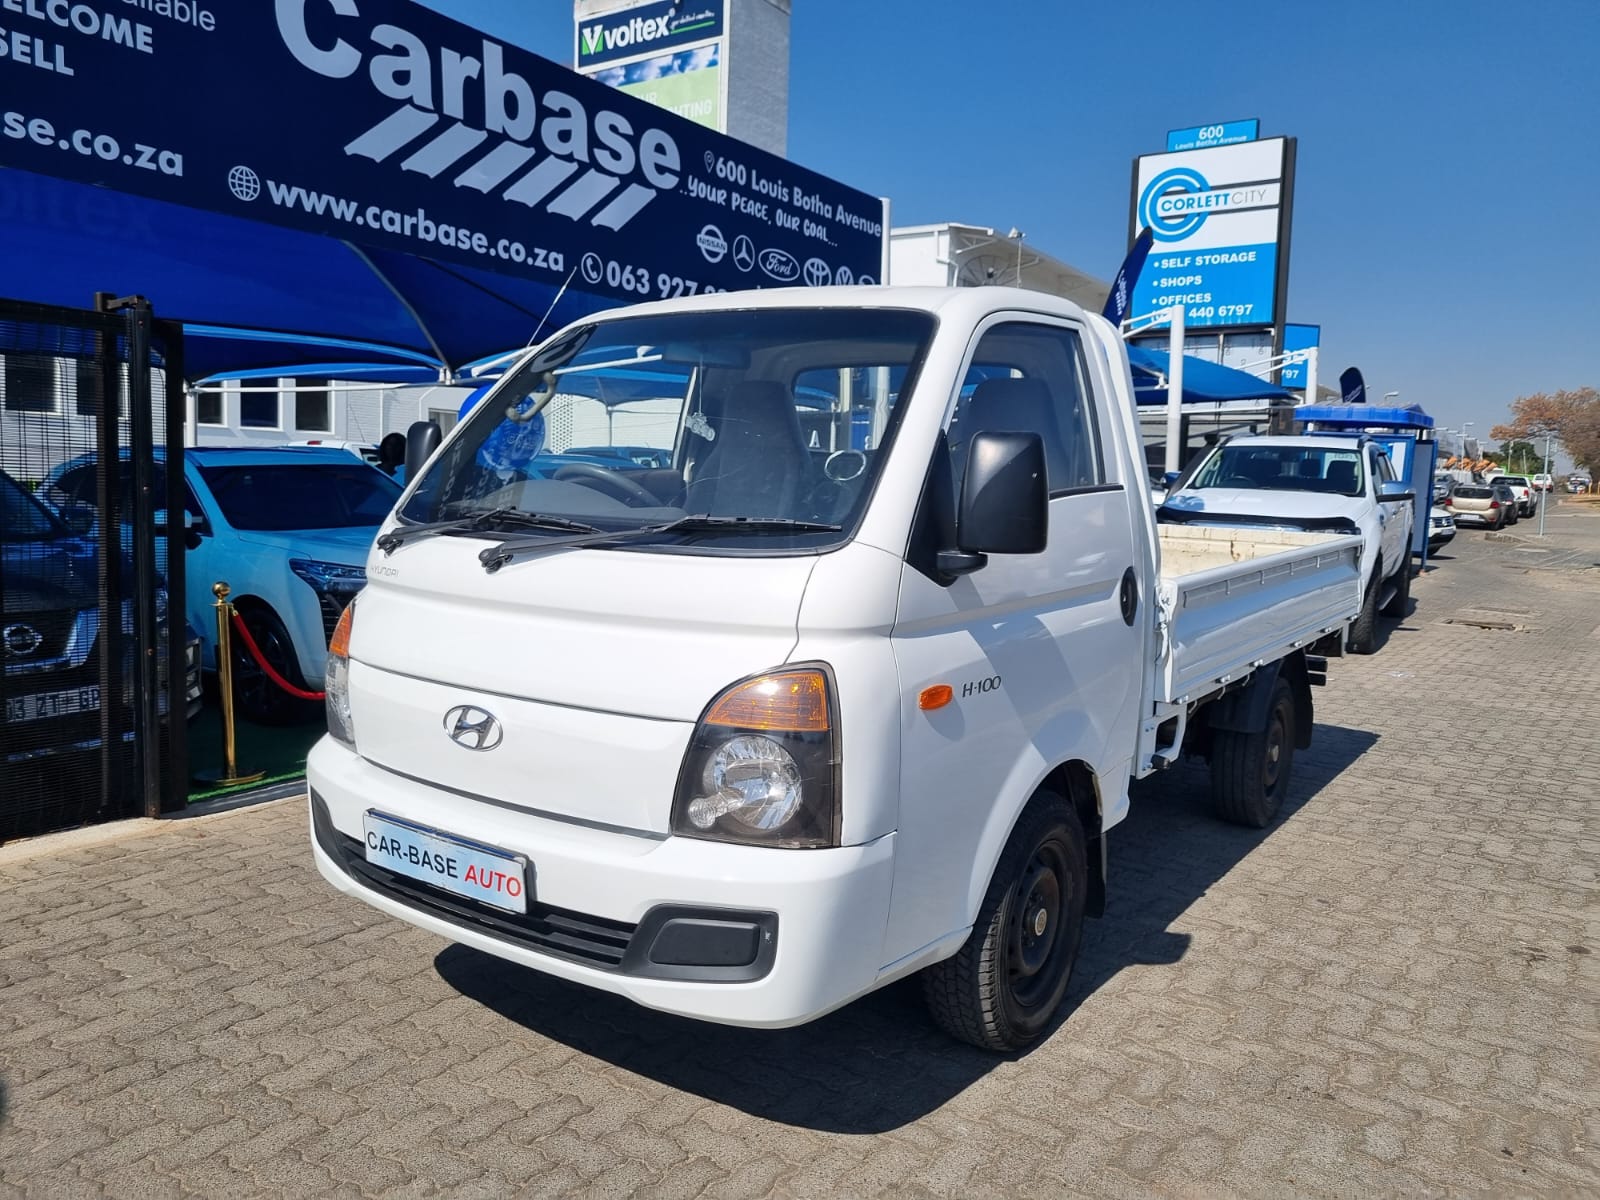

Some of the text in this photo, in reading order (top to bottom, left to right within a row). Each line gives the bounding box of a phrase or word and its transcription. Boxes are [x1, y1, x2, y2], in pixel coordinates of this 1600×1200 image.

[121, 0, 216, 31] able
[604, 15, 670, 50] voltex
[274, 0, 681, 189] Carbase
[3, 111, 184, 177] se.co.za
[1199, 125, 1224, 140] 600
[716, 156, 882, 238] 600 Louis Botha Avenue
[266, 180, 565, 273] www.carbase.co.za
[775, 208, 801, 232] OUR
[766, 253, 794, 276] Ford
[1161, 251, 1257, 269] SELF STORAGE
[606, 260, 698, 299] 063 927
[1160, 275, 1202, 288] SHOPS
[1158, 293, 1212, 306] OFFICES
[1188, 306, 1214, 319] 440
[1218, 303, 1254, 317] 6797
[367, 831, 522, 897] CAR-BASE AUTO
